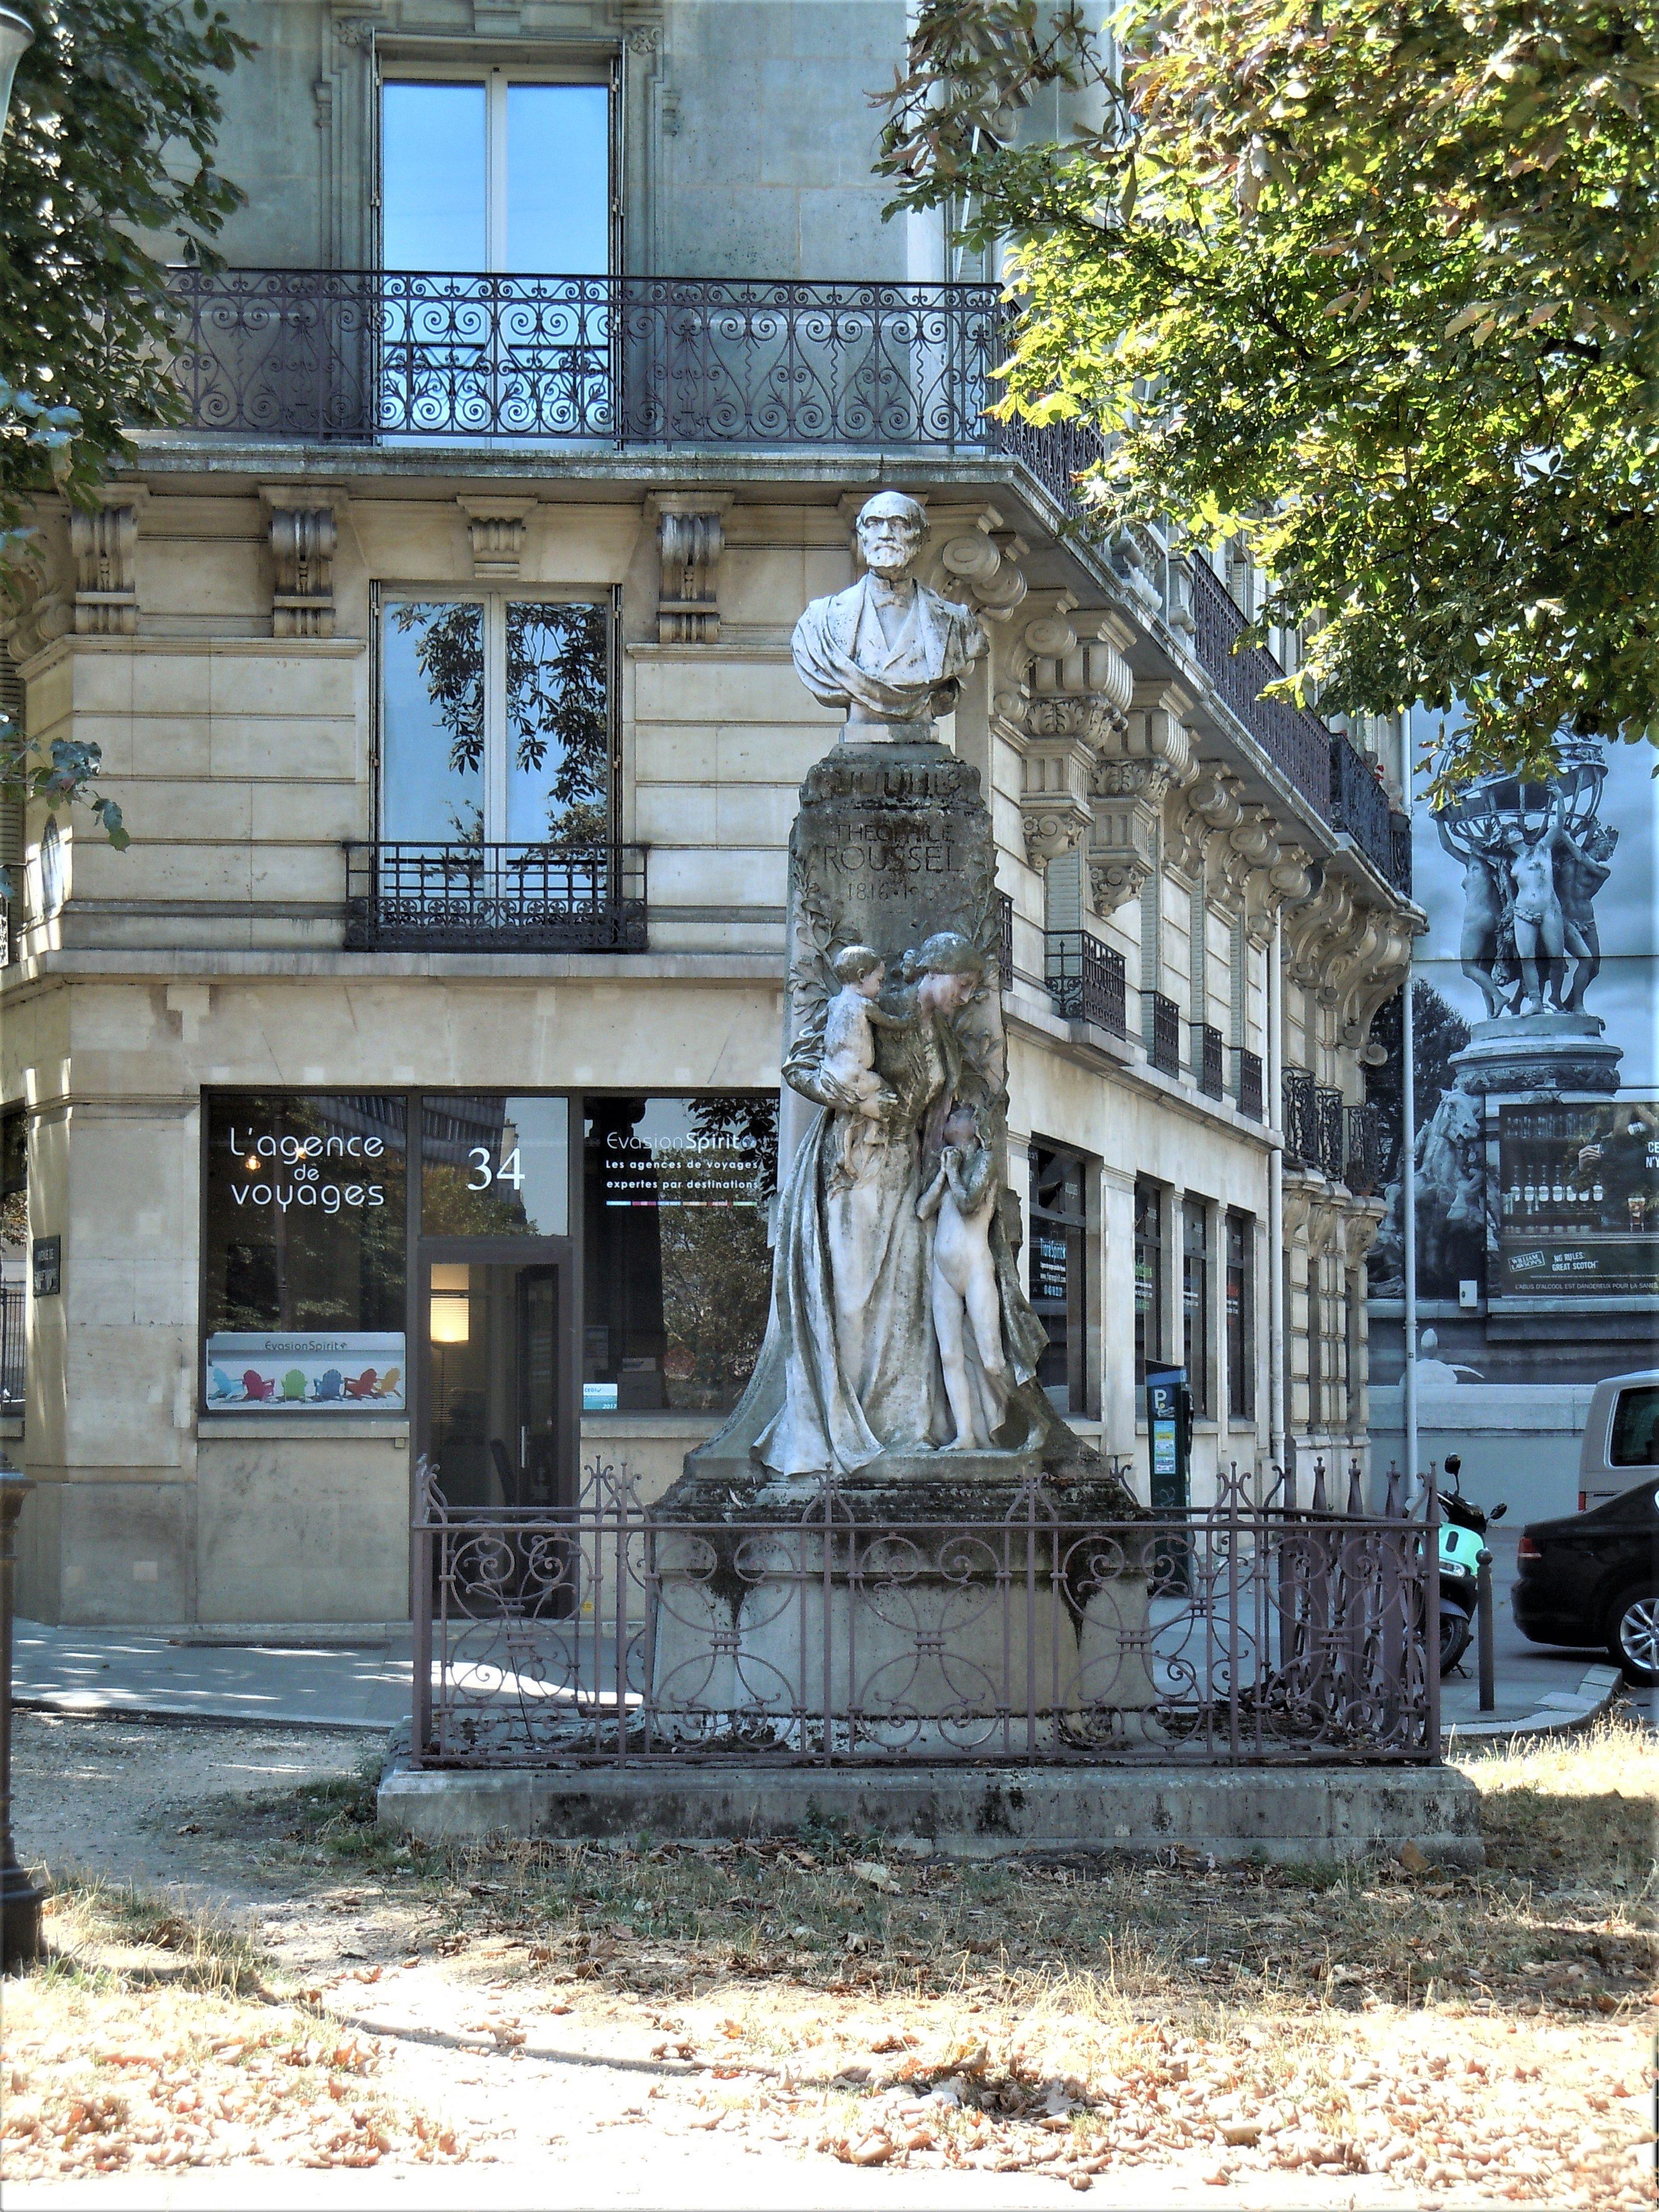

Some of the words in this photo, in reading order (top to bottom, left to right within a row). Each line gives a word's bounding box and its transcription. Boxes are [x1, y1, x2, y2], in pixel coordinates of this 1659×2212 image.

[823, 845, 965, 874] ROUSSEL
[230, 1127, 385, 1165] L'agence
[293, 1164, 320, 1182] de
[466, 1146, 526, 1192] 34
[606, 1160, 624, 1169] Les
[629, 1160, 682, 1171] agences
[687, 1160, 702, 1169] de
[707, 1161, 758, 1171] voyages
[606, 1179, 658, 1190] expertes
[663, 1181, 682, 1190] par
[686, 1179, 758, 1189] destinations
[231, 1183, 385, 1215] voyages
[1552, 1262, 1570, 1272] GREAT
